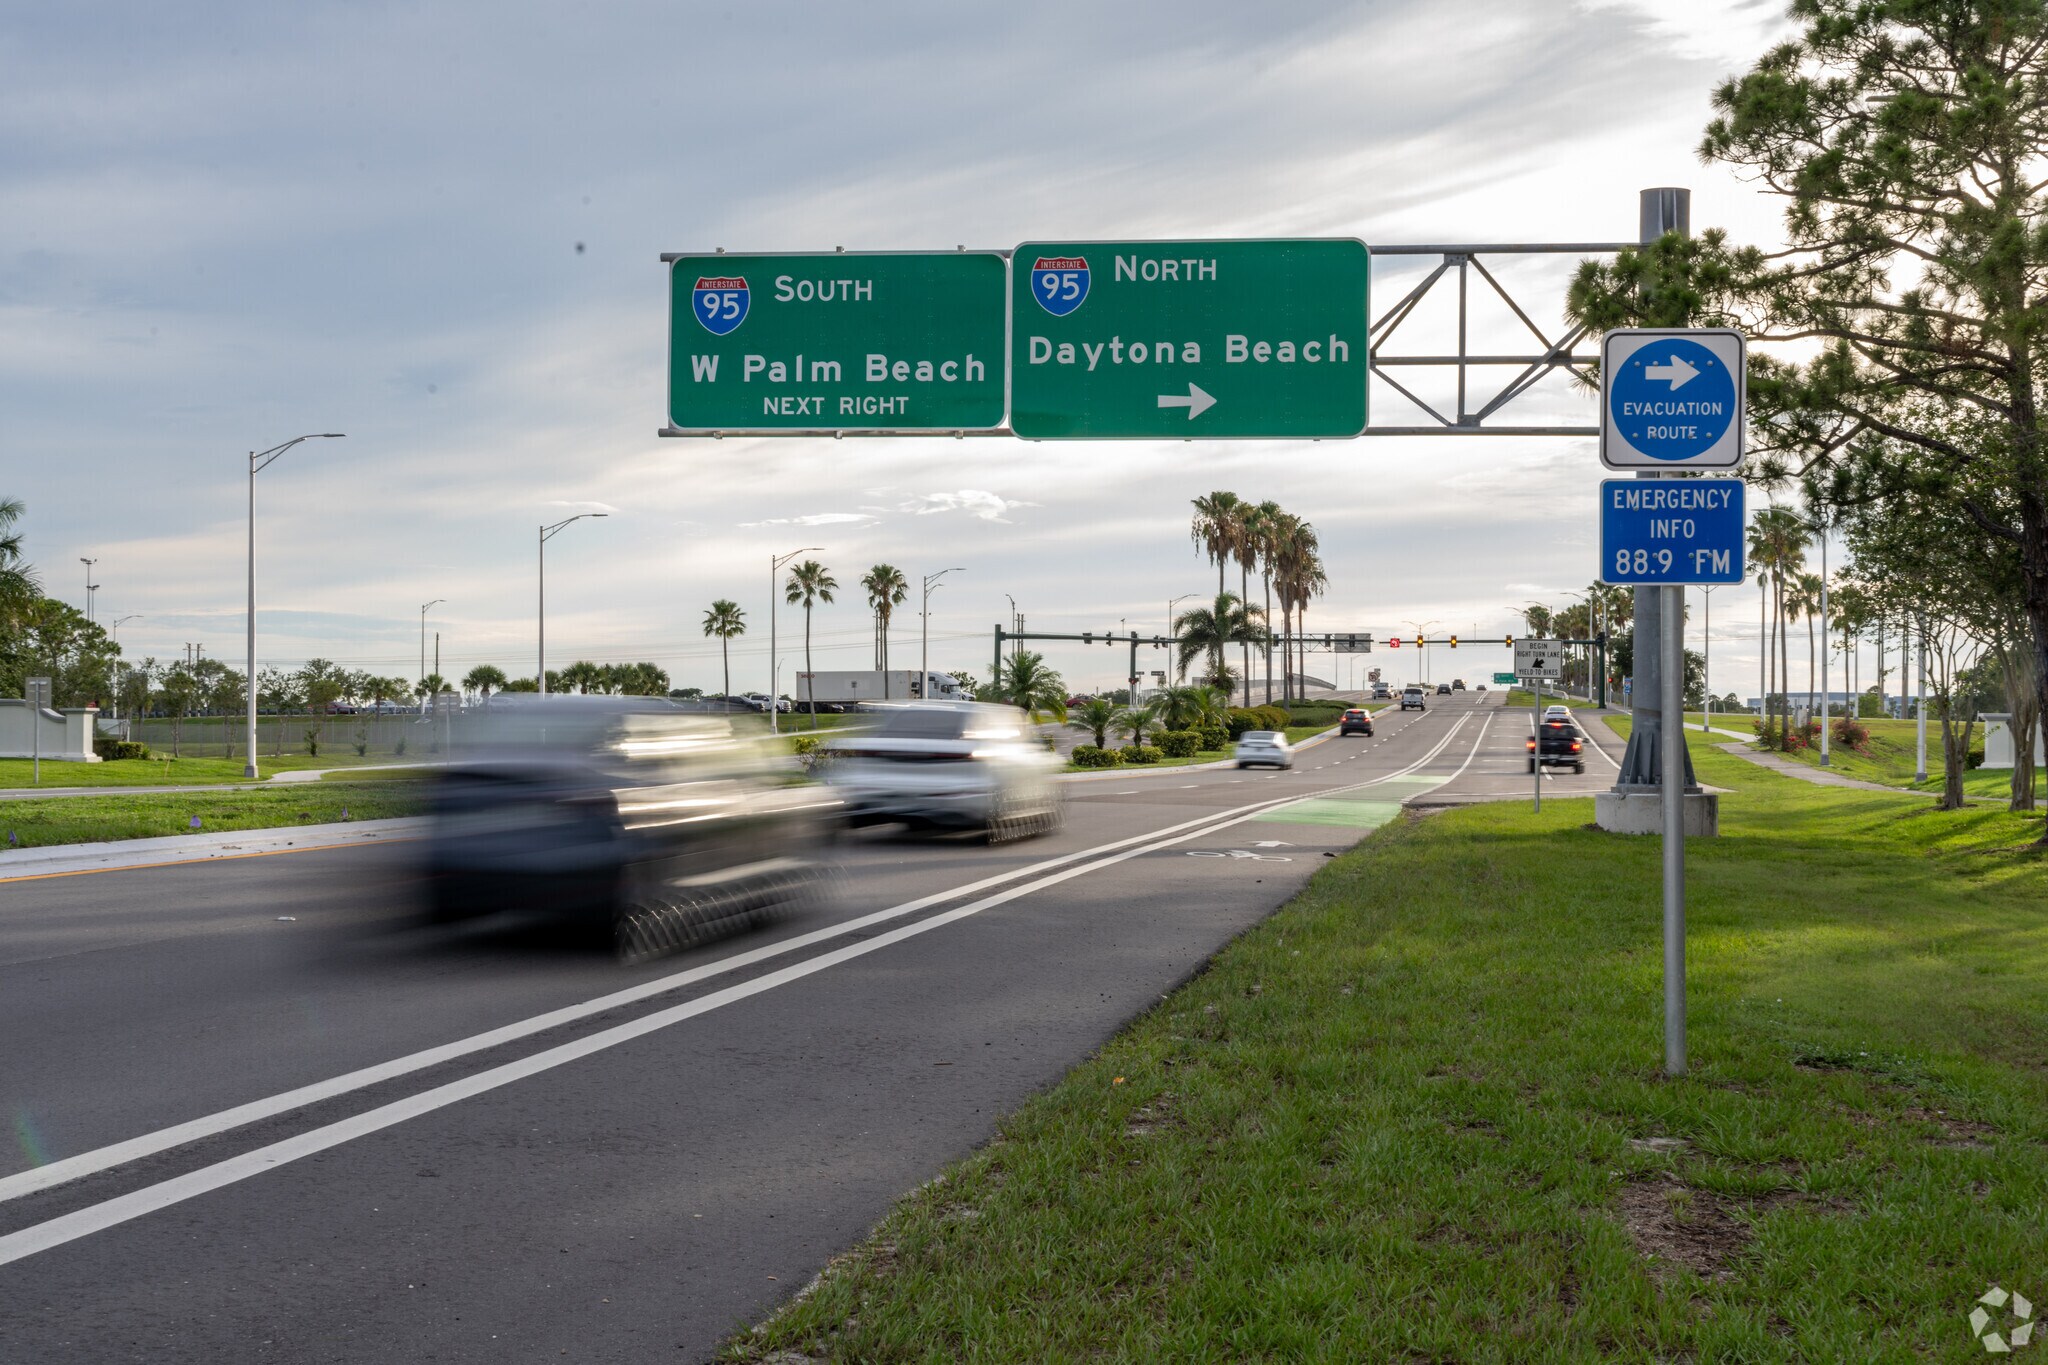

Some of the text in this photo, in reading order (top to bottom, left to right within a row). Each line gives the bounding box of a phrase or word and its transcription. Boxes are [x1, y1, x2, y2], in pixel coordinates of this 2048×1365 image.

[1041, 261, 1081, 269] INTERSTATE
[701, 280, 741, 289] INTERSTATE
[1042, 273, 1080, 300] 95
[703, 293, 740, 320] 95
[1029, 333, 1349, 371] Daytona Beach
[691, 353, 985, 382] W Palm Beach
[764, 396, 909, 415] NEXT RIGHT
[1623, 402, 1722, 416] EVACUATION
[1647, 426, 1697, 439] ROUTE
[1613, 489, 1732, 509] EMERGENCY
[1650, 519, 1695, 539] INFO
[1616, 549, 1730, 575] 88.9 FM
